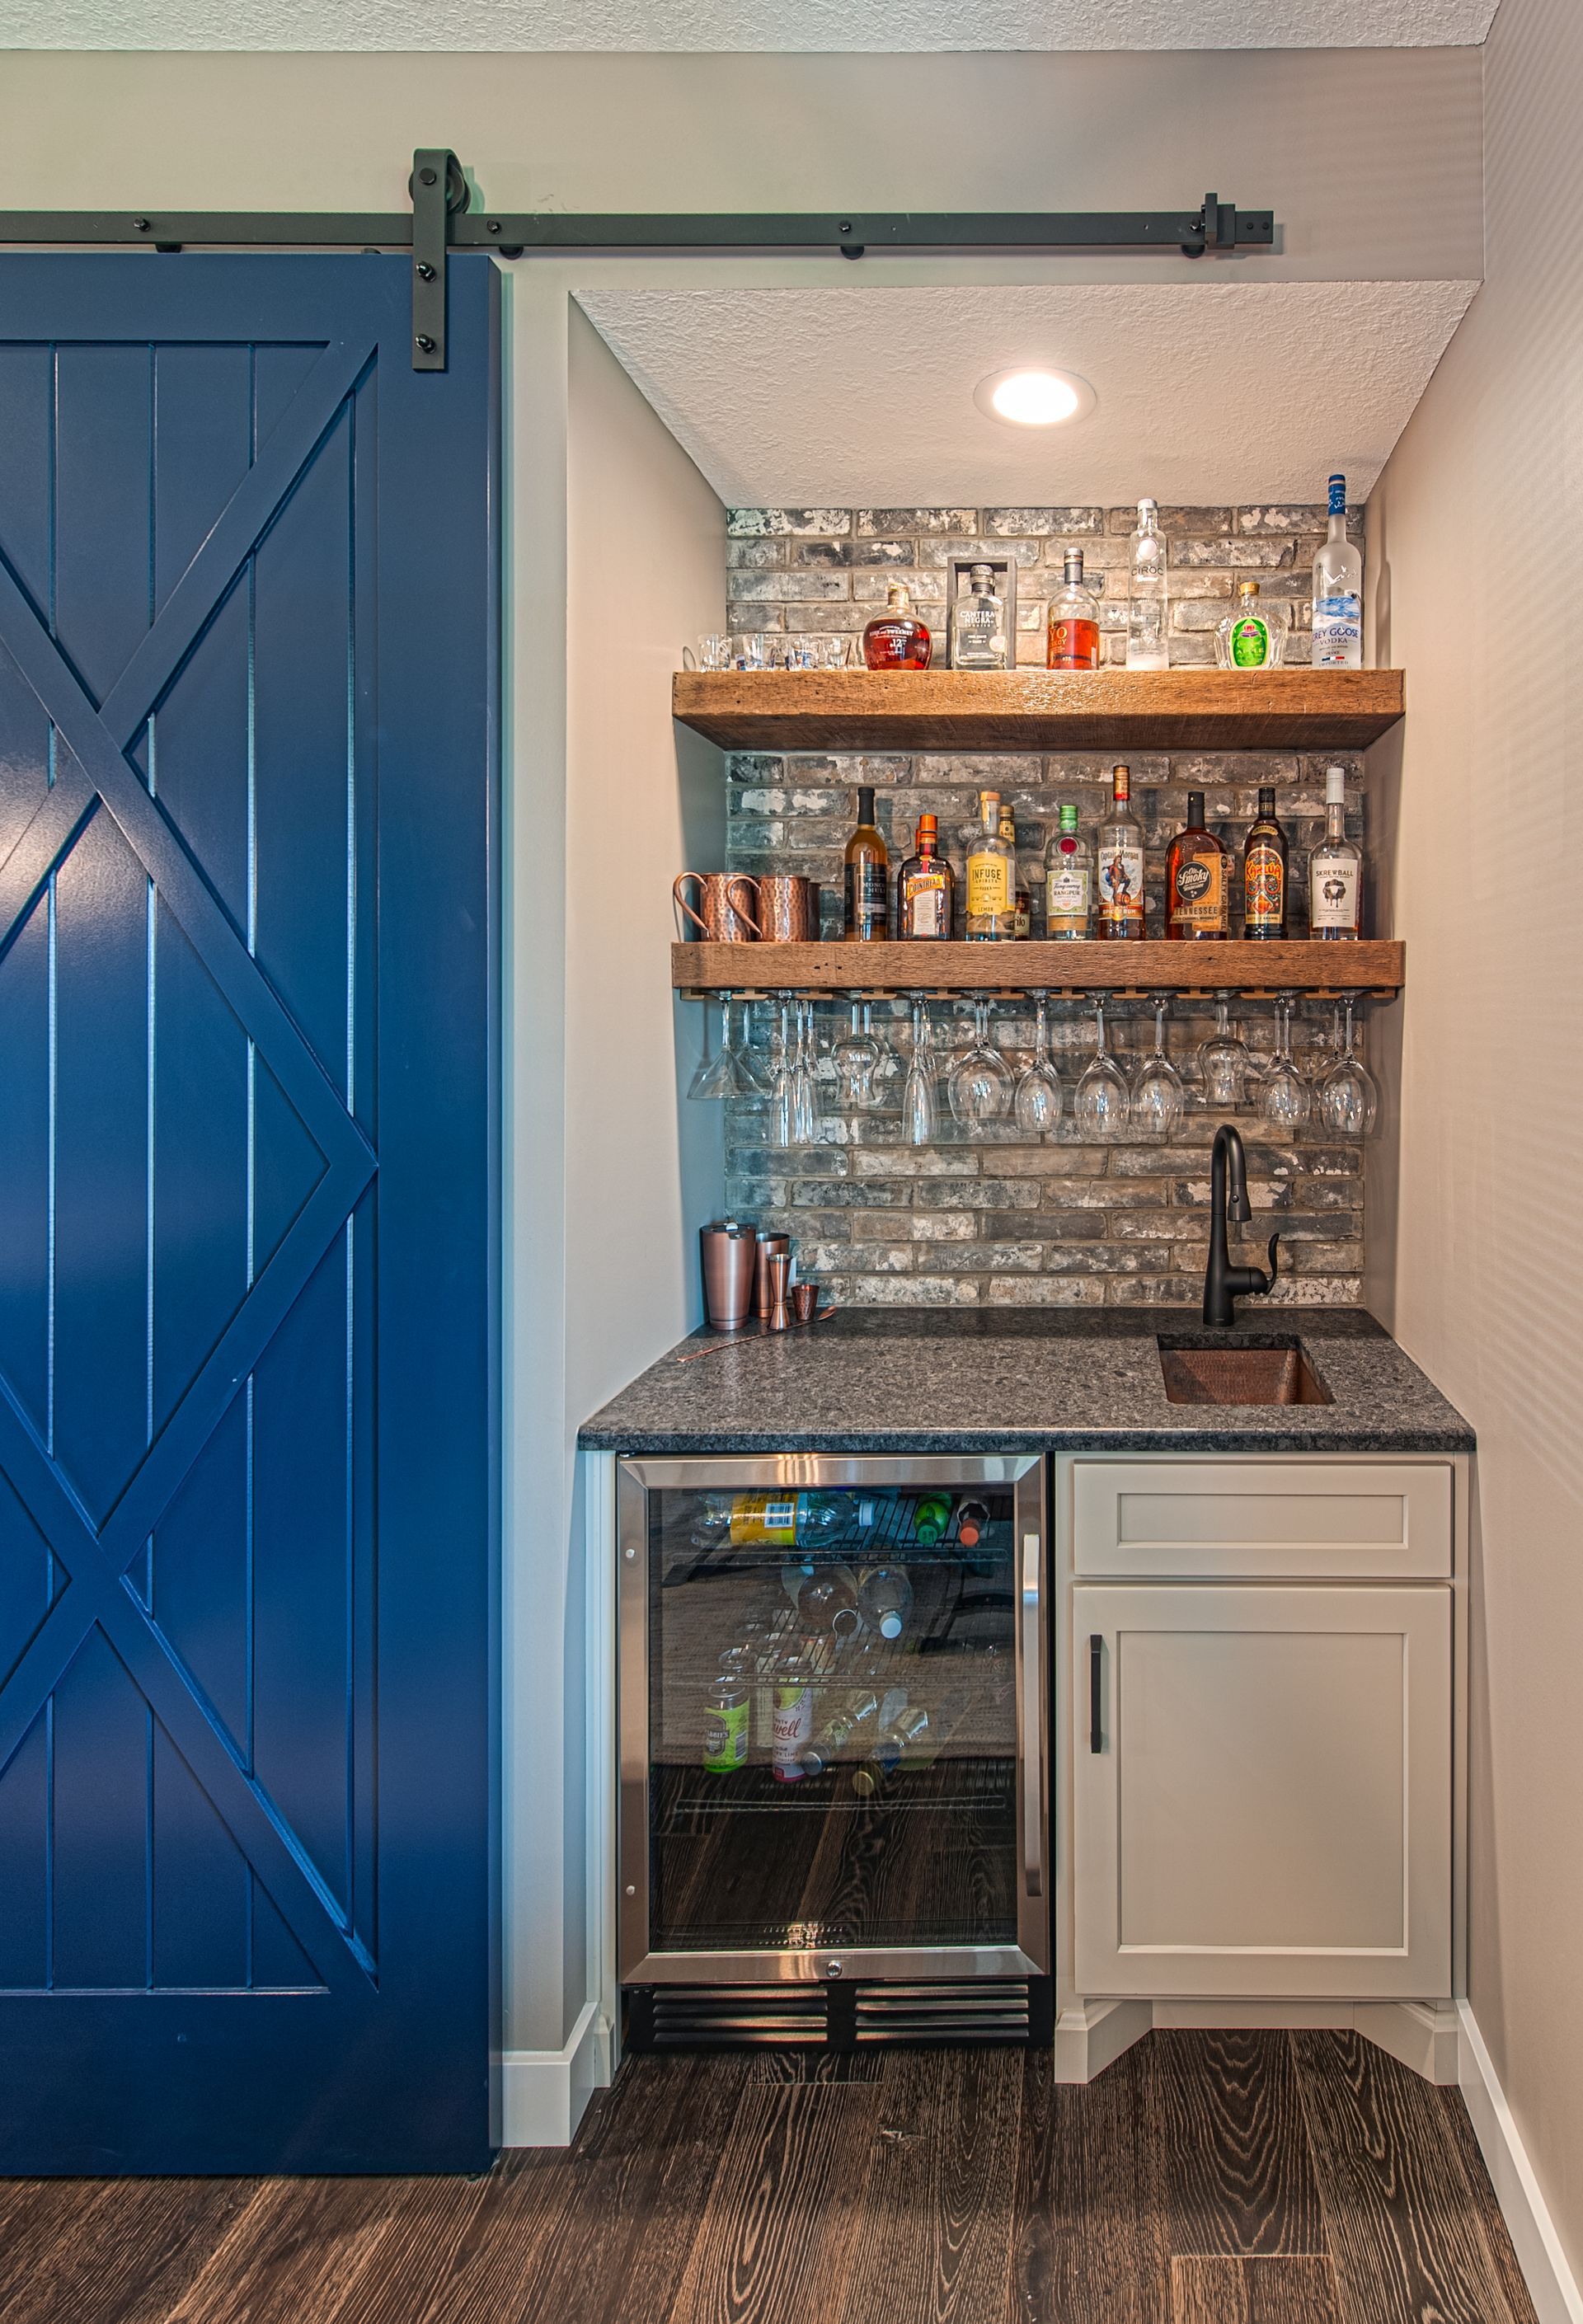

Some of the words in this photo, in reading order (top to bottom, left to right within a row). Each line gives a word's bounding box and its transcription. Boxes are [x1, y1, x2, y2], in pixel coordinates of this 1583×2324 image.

[1329, 627, 1359, 638] GOOSE
[1320, 637, 1348, 646] VODKA
[972, 869, 1002, 881] INFUSE
[1177, 869, 1210, 886] Smoky
[1176, 906, 1218, 916] TENNESSEE
